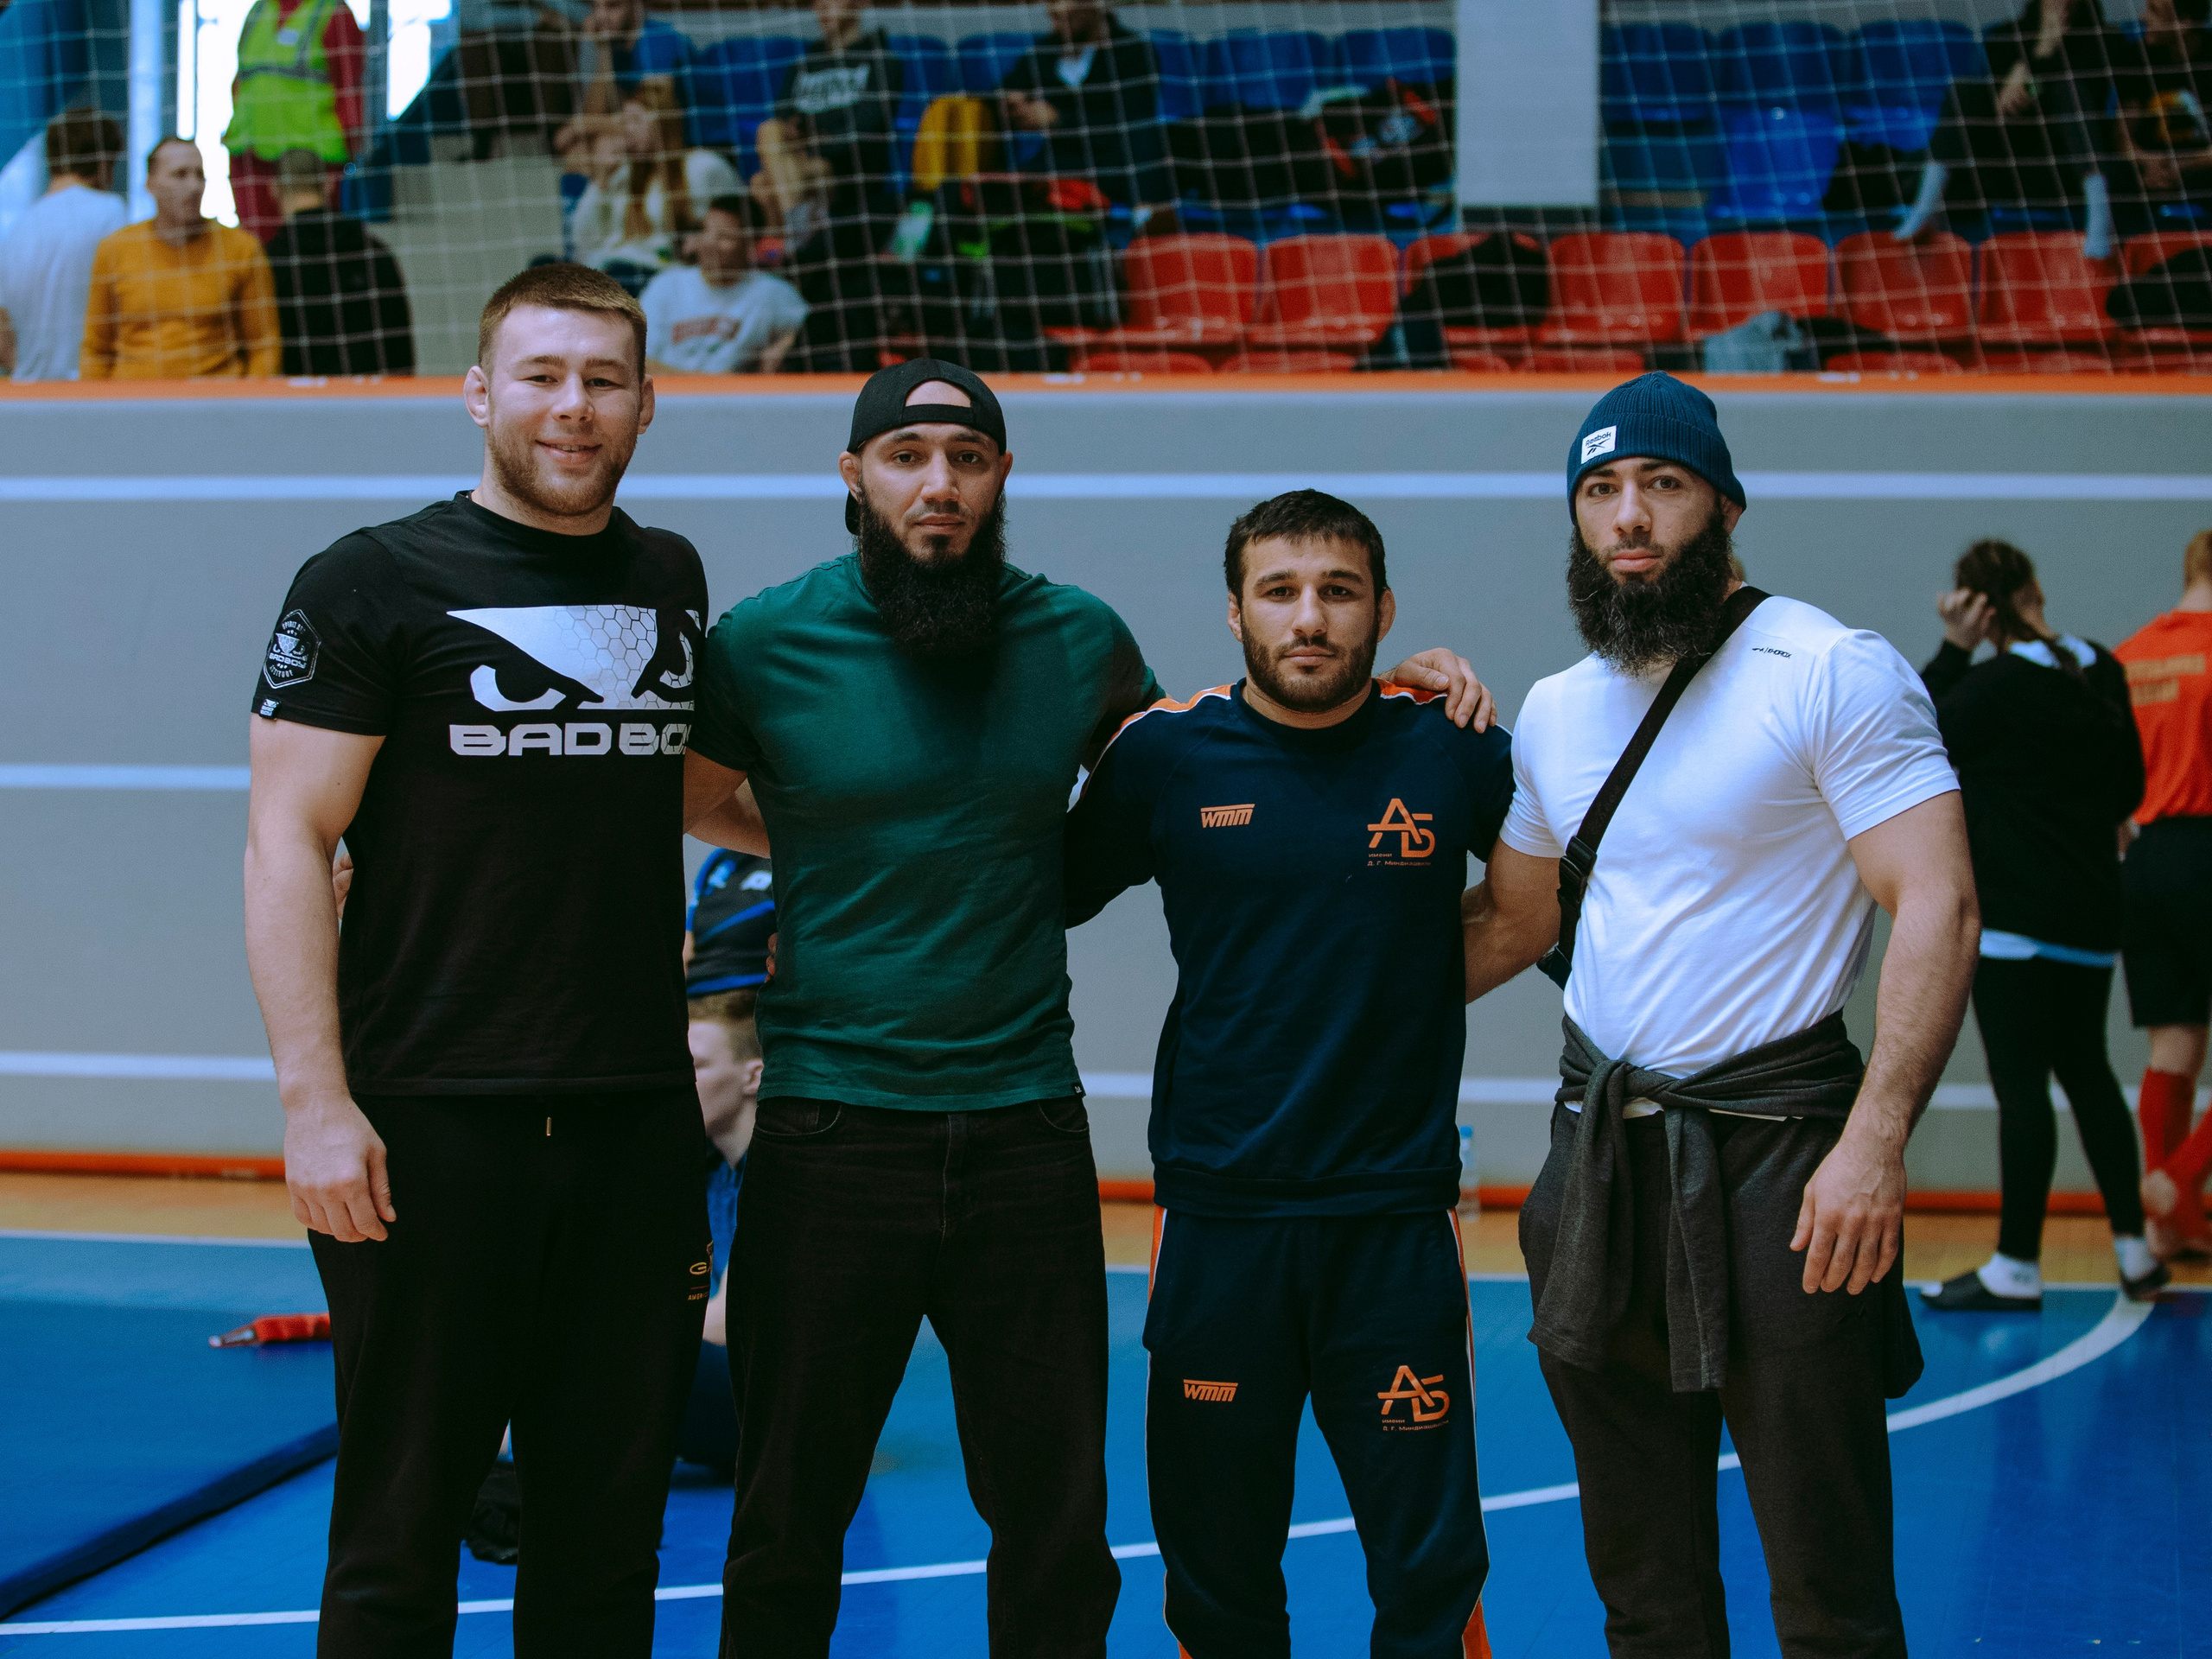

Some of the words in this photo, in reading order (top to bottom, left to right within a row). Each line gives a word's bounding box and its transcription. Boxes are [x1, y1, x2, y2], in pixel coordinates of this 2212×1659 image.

[1586, 431, 1611, 447] Reebok
[448, 723, 613, 756] BAD
[619, 723, 691, 756] BO
